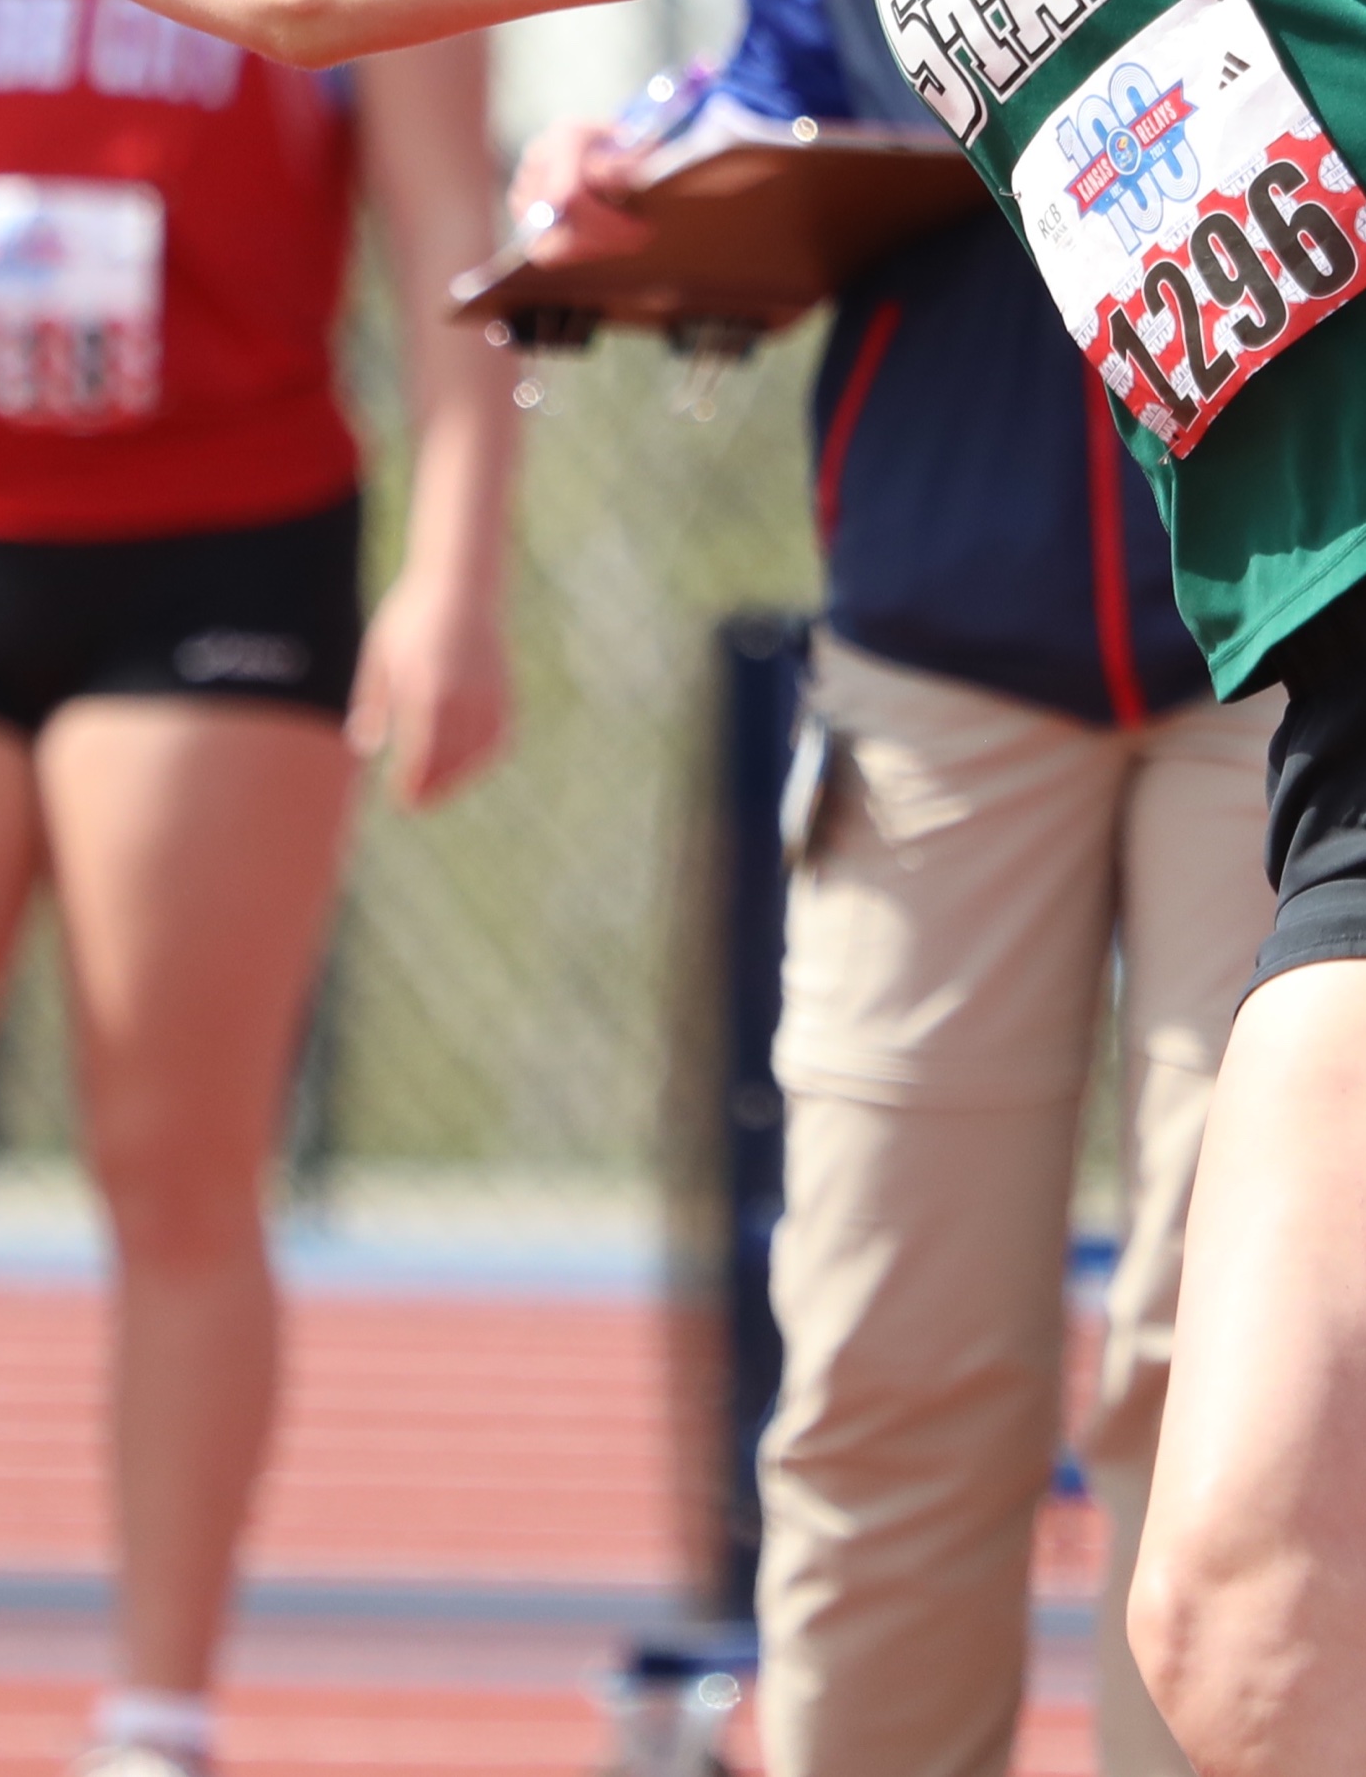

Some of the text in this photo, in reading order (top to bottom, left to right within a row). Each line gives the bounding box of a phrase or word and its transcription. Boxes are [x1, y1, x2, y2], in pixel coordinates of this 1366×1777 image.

[1076, 99, 1178, 203] KANSAS RELAYS
[1037, 203, 1062, 240] RCB
[1108, 159, 1358, 433] 1296
